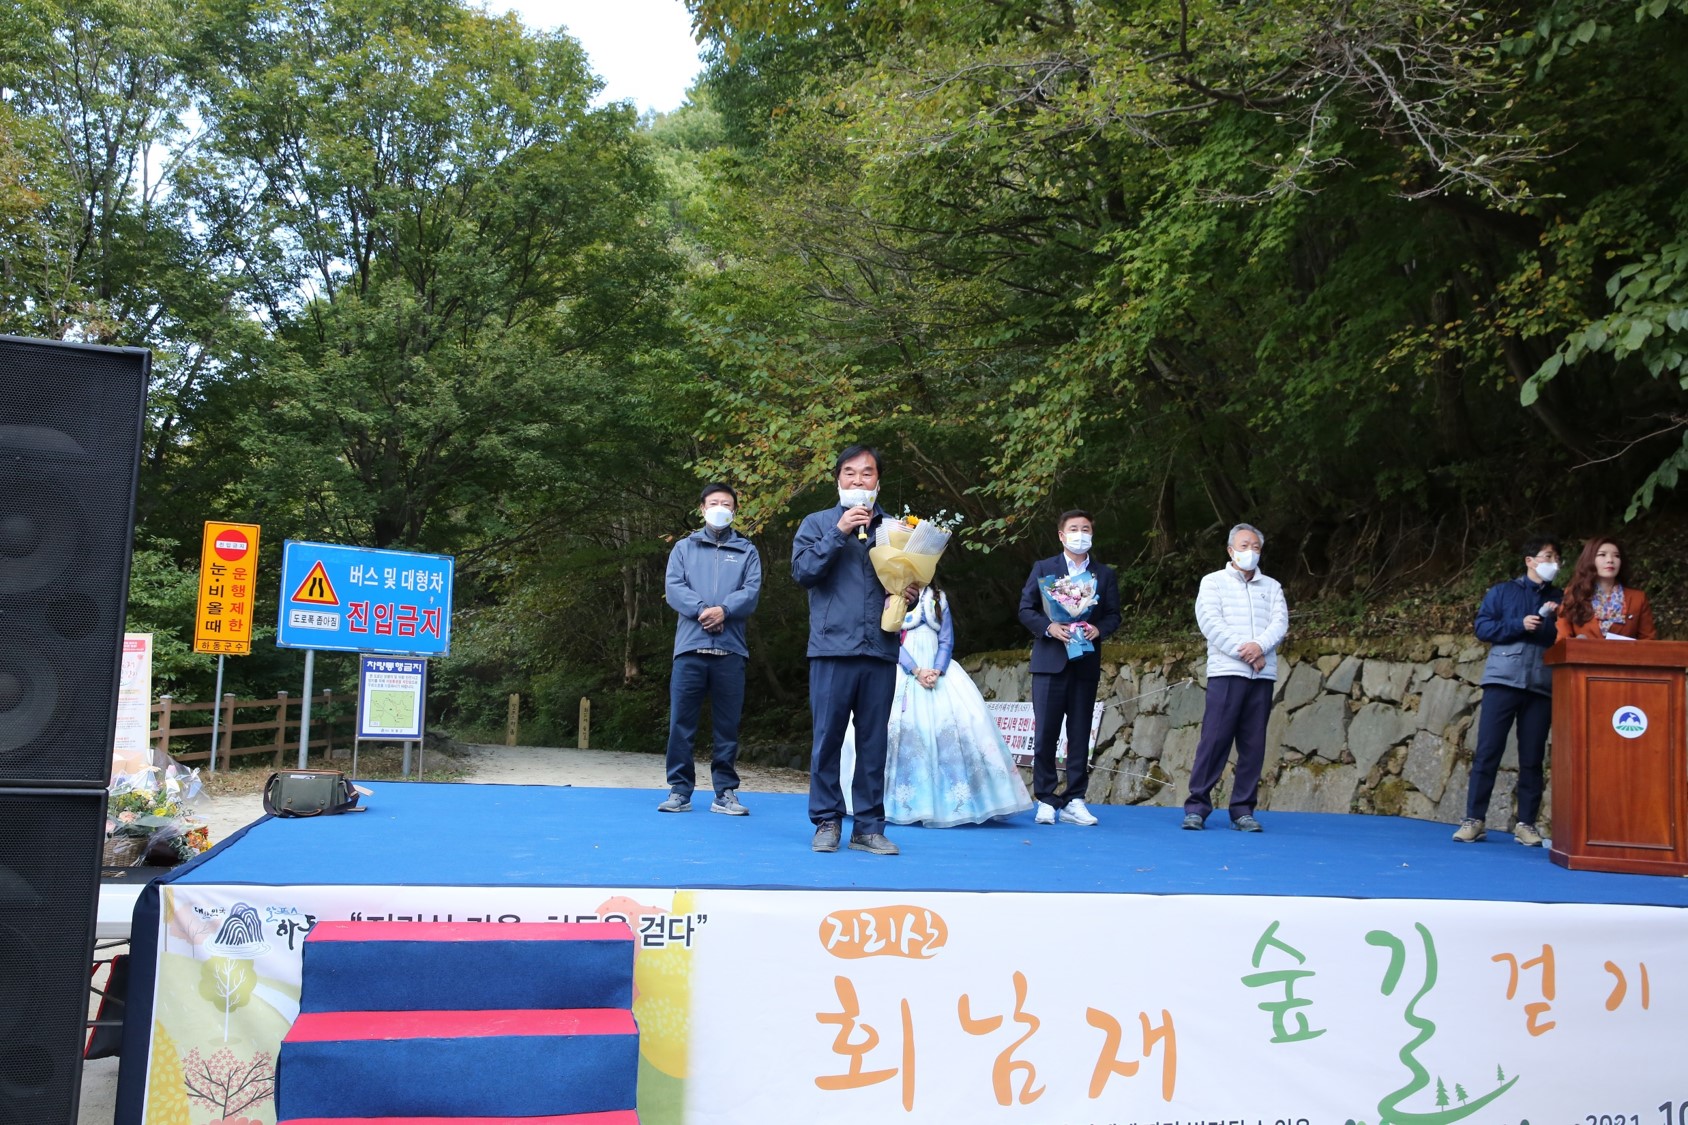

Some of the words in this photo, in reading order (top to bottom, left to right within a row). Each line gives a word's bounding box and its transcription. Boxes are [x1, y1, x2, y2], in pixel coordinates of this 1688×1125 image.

[350, 565, 378, 586] 버스
[384, 567, 396, 589] 및
[401, 569, 443, 594] 대형차
[229, 568, 247, 632] 운행제한
[293, 614, 314, 624] 도로폭
[316, 616, 337, 627] 좁아짐
[346, 600, 442, 639] 진입금지
[201, 641, 243, 651] 하동군수
[367, 661, 421, 672] 차량통행금지
[827, 910, 945, 957] 지리산
[815, 970, 1177, 1112] 회남재
[1491, 943, 1650, 1037] 걷기
